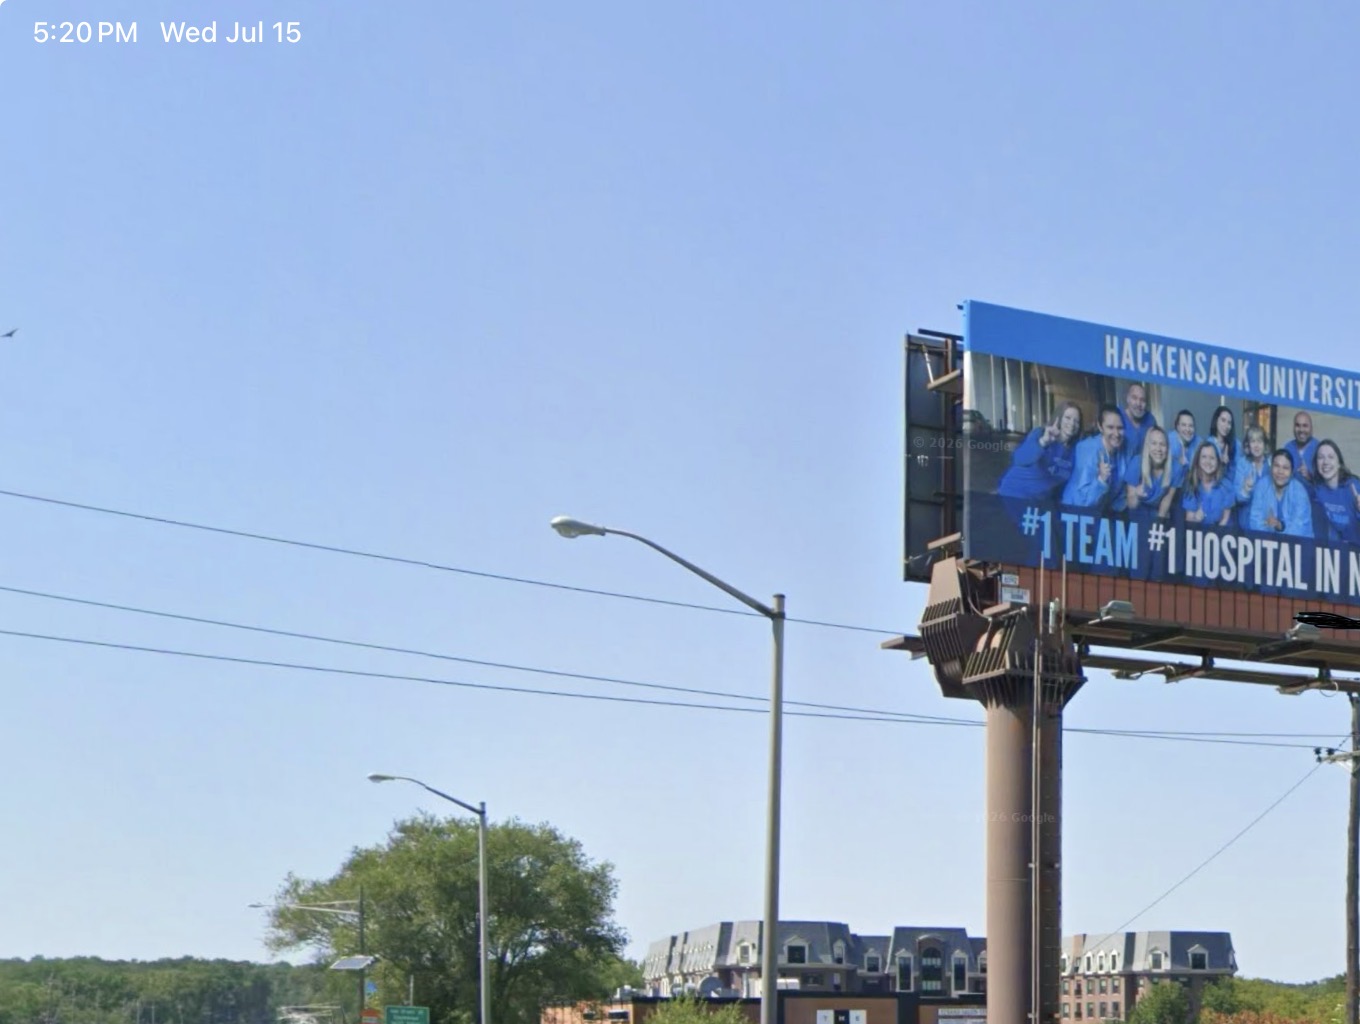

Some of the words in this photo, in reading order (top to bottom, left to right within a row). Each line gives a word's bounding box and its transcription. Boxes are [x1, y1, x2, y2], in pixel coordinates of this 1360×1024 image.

[1104, 333, 1250, 393] HACKENSACK
[1022, 506, 1052, 560] #1
[1060, 512, 1139, 570] TEAM
[1147, 522, 1177, 575] #1
[1185, 529, 1308, 591] HOSPITAL
[1315, 546, 1341, 595] IN
